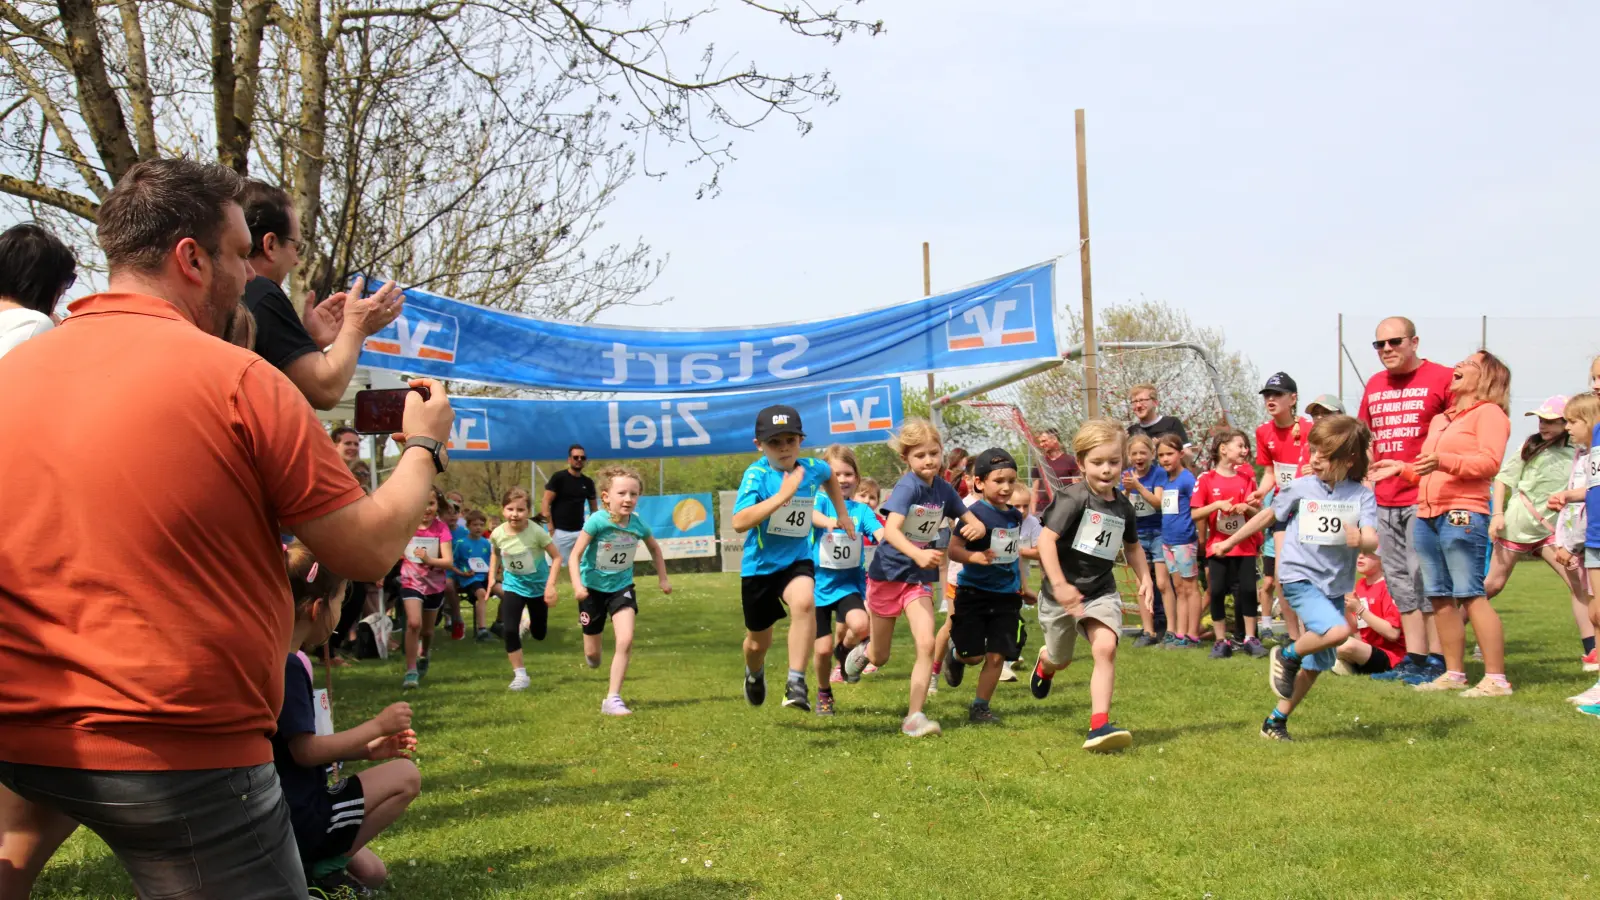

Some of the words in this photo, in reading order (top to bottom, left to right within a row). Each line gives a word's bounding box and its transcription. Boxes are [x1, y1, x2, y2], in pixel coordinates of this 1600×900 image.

[1381, 389, 1401, 400] SIND
[1402, 387, 1429, 398] DOCH
[1382, 401, 1402, 413] NUR
[1402, 399, 1425, 411] HIER,
[772, 414, 788, 425] CAT
[1385, 414, 1402, 426] UNS
[1402, 412, 1419, 424] DIE
[1391, 426, 1421, 438] NICHT
[1280, 472, 1293, 483] 95
[1134, 501, 1146, 511] 62
[785, 510, 806, 527] 48
[1225, 520, 1238, 530] 69
[1318, 516, 1342, 533] 39
[917, 520, 936, 534] 47
[1095, 530, 1112, 547] 41
[610, 552, 627, 565] 42
[833, 545, 851, 560] 50
[509, 560, 524, 570] 43
